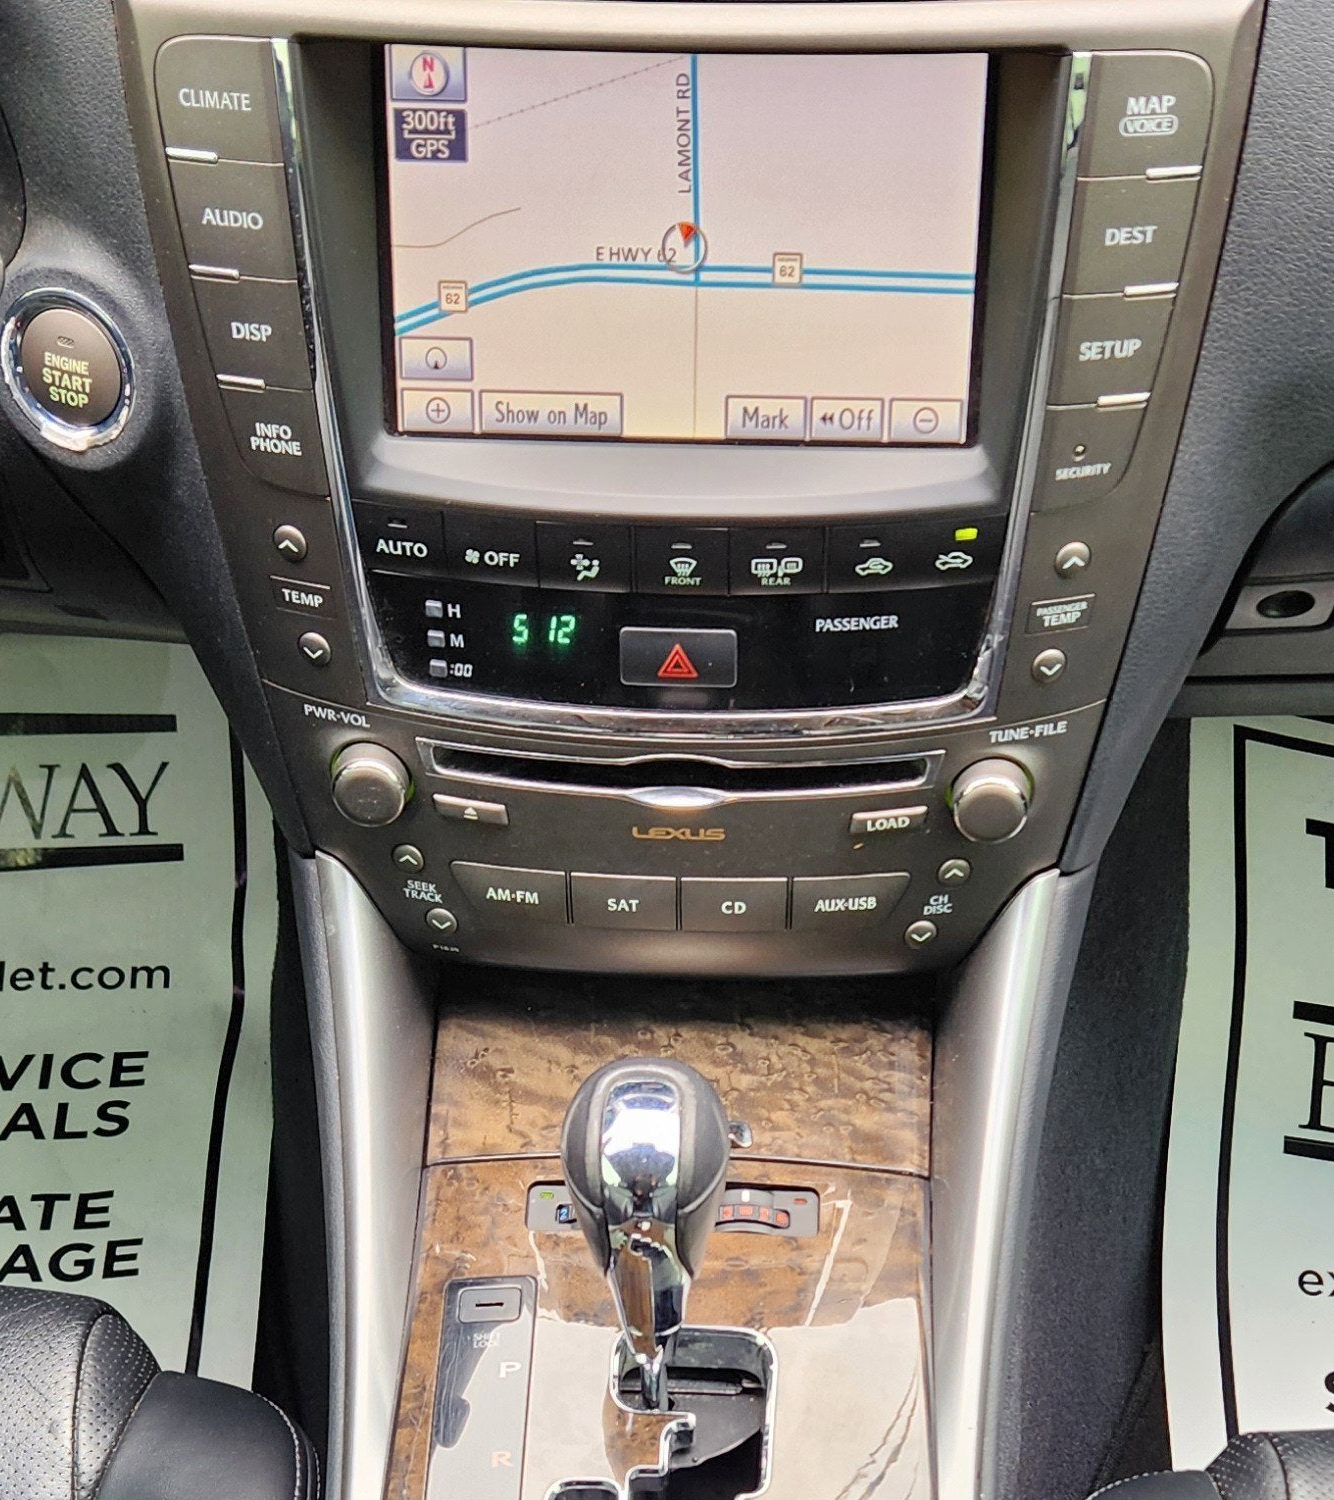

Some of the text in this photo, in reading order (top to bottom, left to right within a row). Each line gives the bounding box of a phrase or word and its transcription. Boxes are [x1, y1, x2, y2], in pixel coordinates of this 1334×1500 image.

[422, 56, 435, 73] N
[178, 87, 252, 111] CLIMATE
[1126, 95, 1176, 115] MAP
[401, 110, 456, 131] 300ft
[1125, 118, 1173, 133] VOICE
[676, 72, 693, 194] LAMONT RD
[410, 139, 450, 159] GPS
[201, 207, 264, 230] AUDIO
[1104, 226, 1157, 246] DEST
[596, 246, 604, 261] E
[610, 247, 652, 261] HWY
[231, 321, 272, 341] DISP
[1078, 339, 1142, 361] SETUP
[44, 352, 89, 374] ENGINE
[42, 368, 93, 394] START
[49, 387, 89, 408] STOP
[495, 401, 608, 430] Show on Map
[742, 407, 789, 430] Mark
[839, 408, 874, 430] Off
[256, 423, 292, 440] INFO
[250, 436, 302, 456] PHONE
[1055, 463, 1111, 480] SECURITY
[375, 538, 428, 559] AUTO
[484, 550, 521, 568] OFF
[664, 575, 701, 587] FRONT
[761, 576, 791, 587] REAR
[282, 588, 324, 608] TEMP
[447, 603, 461, 619] H
[1042, 611, 1082, 628] TEMP
[815, 614, 899, 633] PASSENGER
[449, 633, 464, 649] M
[867, 816, 910, 832] LOAD
[632, 826, 726, 841] LEXUS
[407, 879, 436, 893] SEEK
[402, 888, 443, 904] TRACK
[929, 895, 949, 905] CH
[607, 898, 639, 913] SAT
[721, 900, 747, 915] CD
[923, 903, 952, 916] DISC
[499, 1361, 522, 1379] P
[491, 1451, 512, 1468] R
